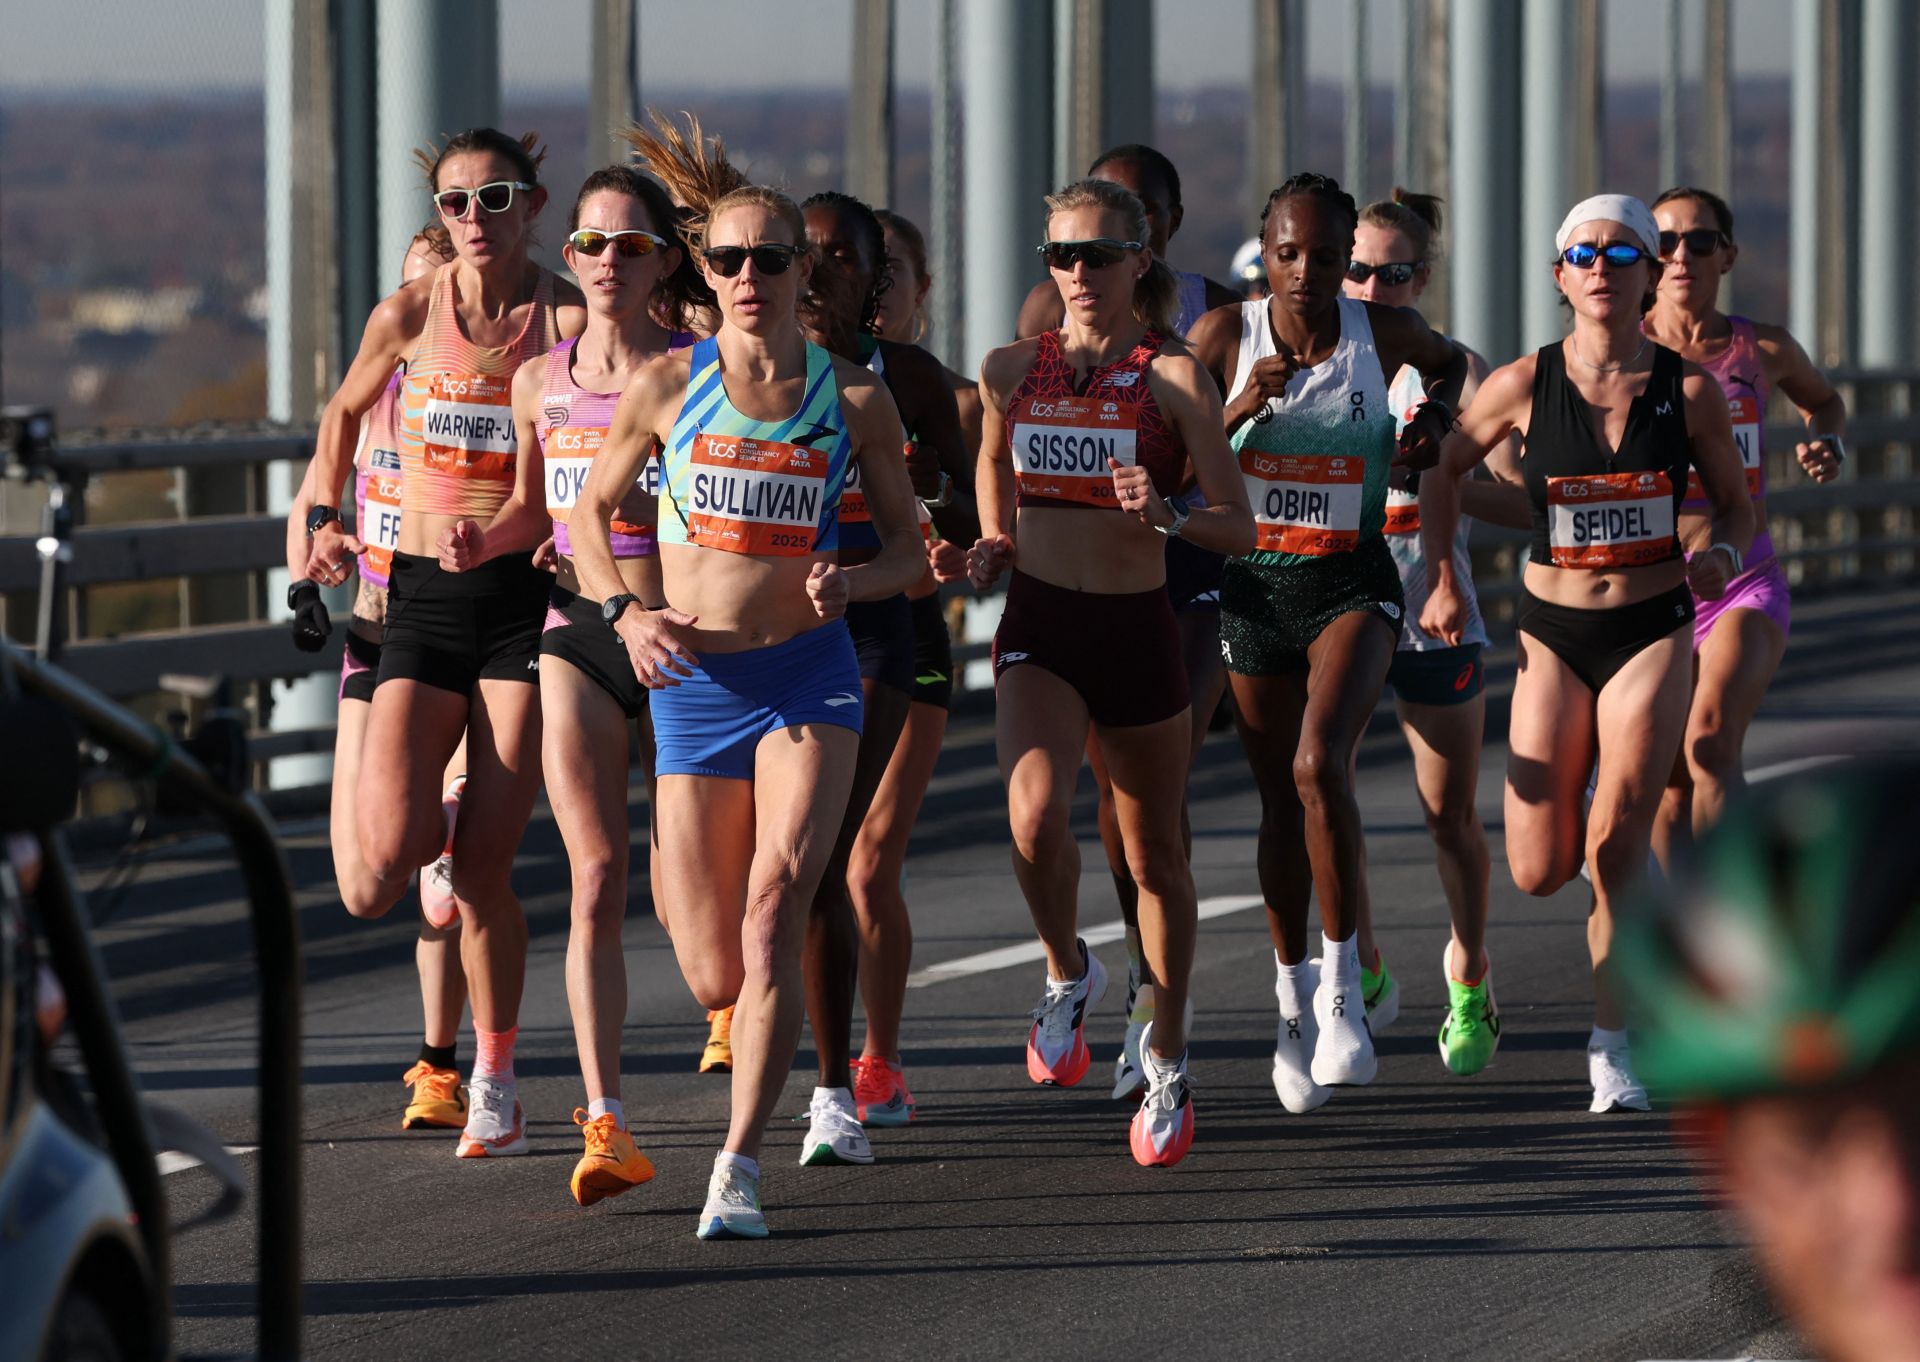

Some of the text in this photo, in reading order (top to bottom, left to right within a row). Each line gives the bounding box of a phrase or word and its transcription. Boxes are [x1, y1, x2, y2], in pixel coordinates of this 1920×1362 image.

[443, 377, 468, 394] tcs
[1030, 400, 1055, 417] tcs
[557, 431, 582, 449] tcs
[740, 441, 757, 449] TATA
[708, 438, 737, 459] tcs
[739, 448, 780, 459] CONSULTANCY
[1028, 433, 1115, 473] SISSON
[738, 455, 765, 463] SERVICES
[789, 459, 811, 468] TATA
[1254, 453, 1279, 474] tcs
[694, 473, 818, 521] SULLIVAN
[1092, 485, 1117, 498] 202
[1563, 482, 1589, 496] tcs
[1637, 485, 1657, 493] TATA
[1265, 487, 1330, 525] OBIRI
[1573, 507, 1652, 543] SEIDEL
[771, 533, 808, 548] 2025
[1314, 536, 1353, 550] 2025
